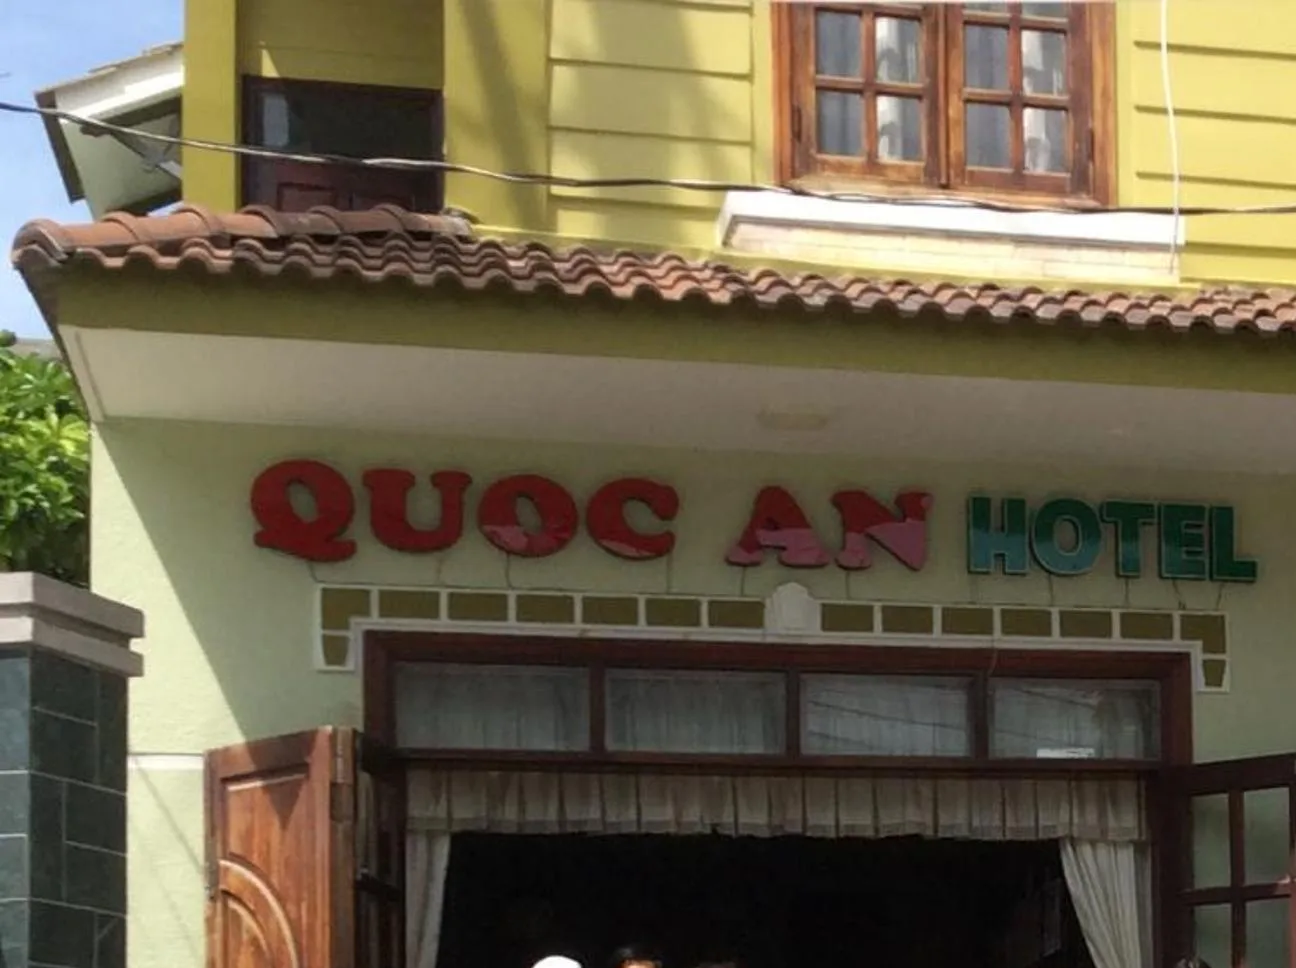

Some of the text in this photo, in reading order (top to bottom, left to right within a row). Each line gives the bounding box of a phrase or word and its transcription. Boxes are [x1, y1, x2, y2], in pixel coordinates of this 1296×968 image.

[251, 460, 1257, 582] QUOC AN HOTEL
